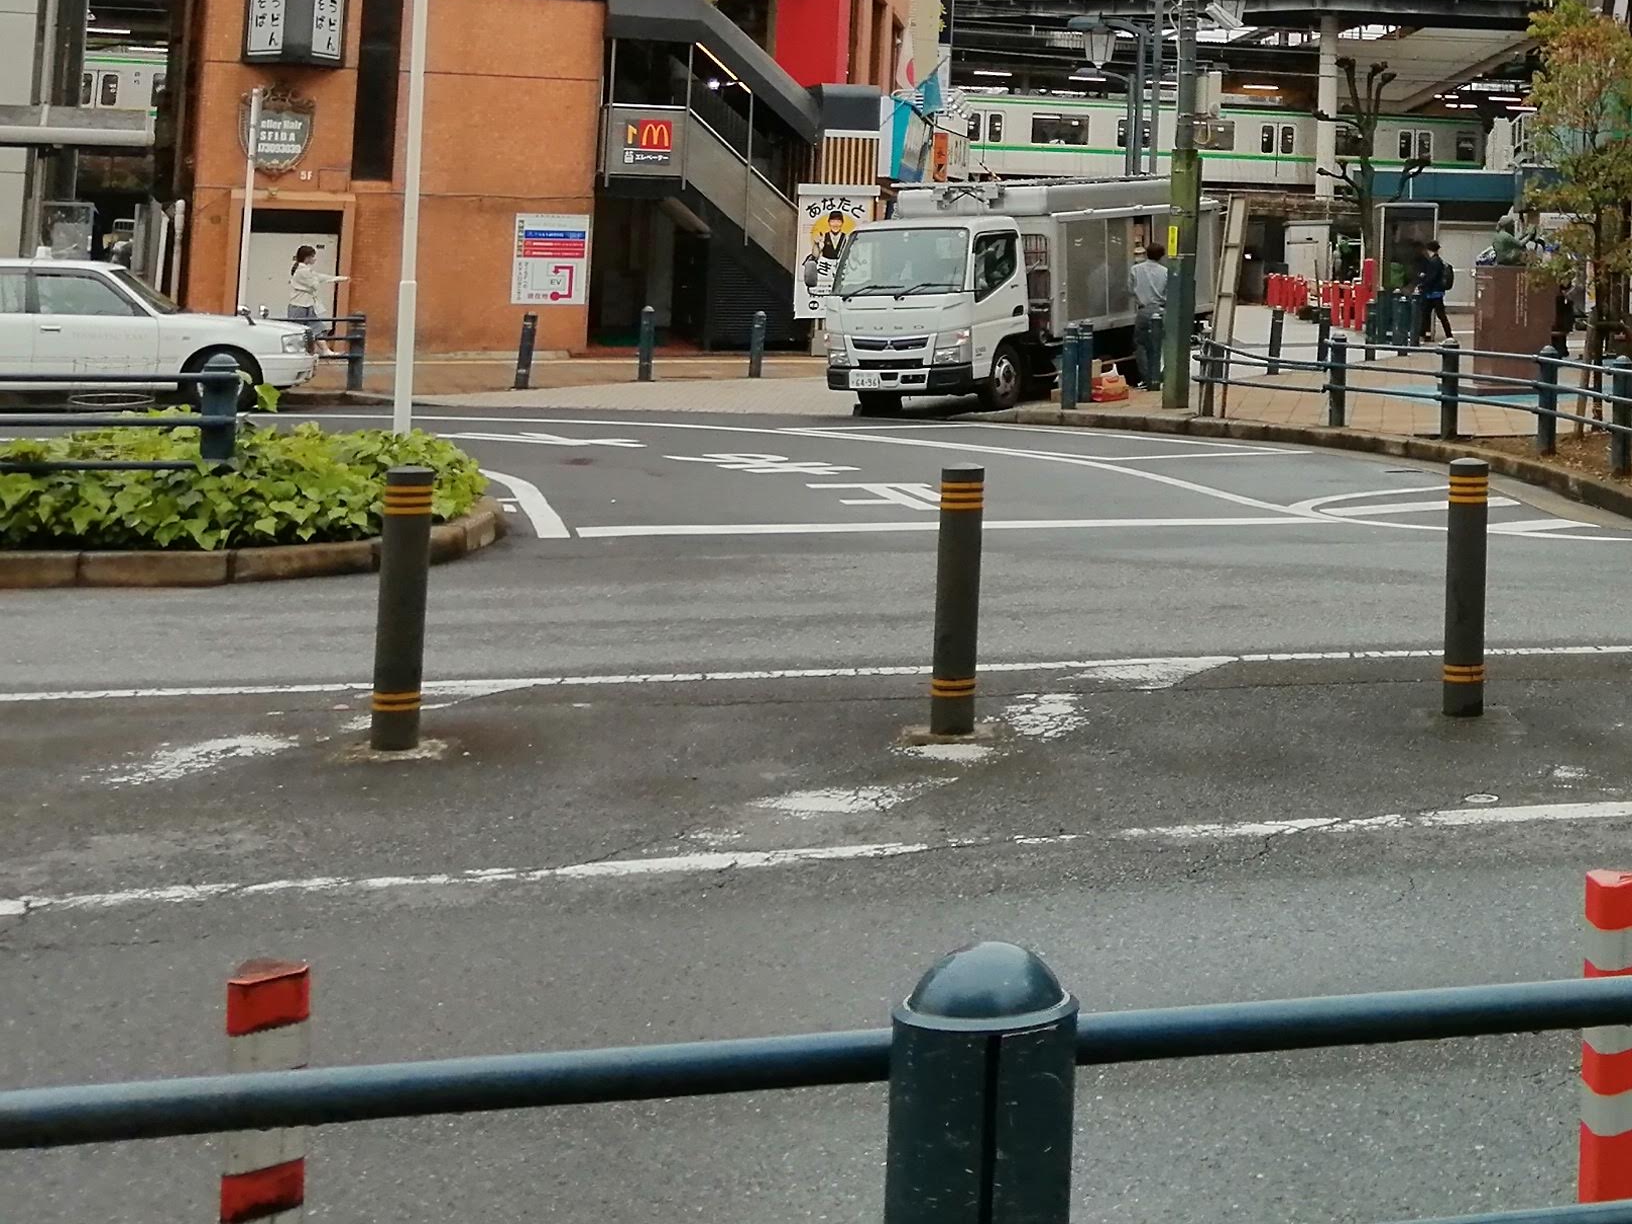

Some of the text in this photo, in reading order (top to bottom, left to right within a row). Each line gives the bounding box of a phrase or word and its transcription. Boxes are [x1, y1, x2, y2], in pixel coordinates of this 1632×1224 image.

[300, 170, 313, 180] 5F
[806, 197, 865, 219] あなたと
